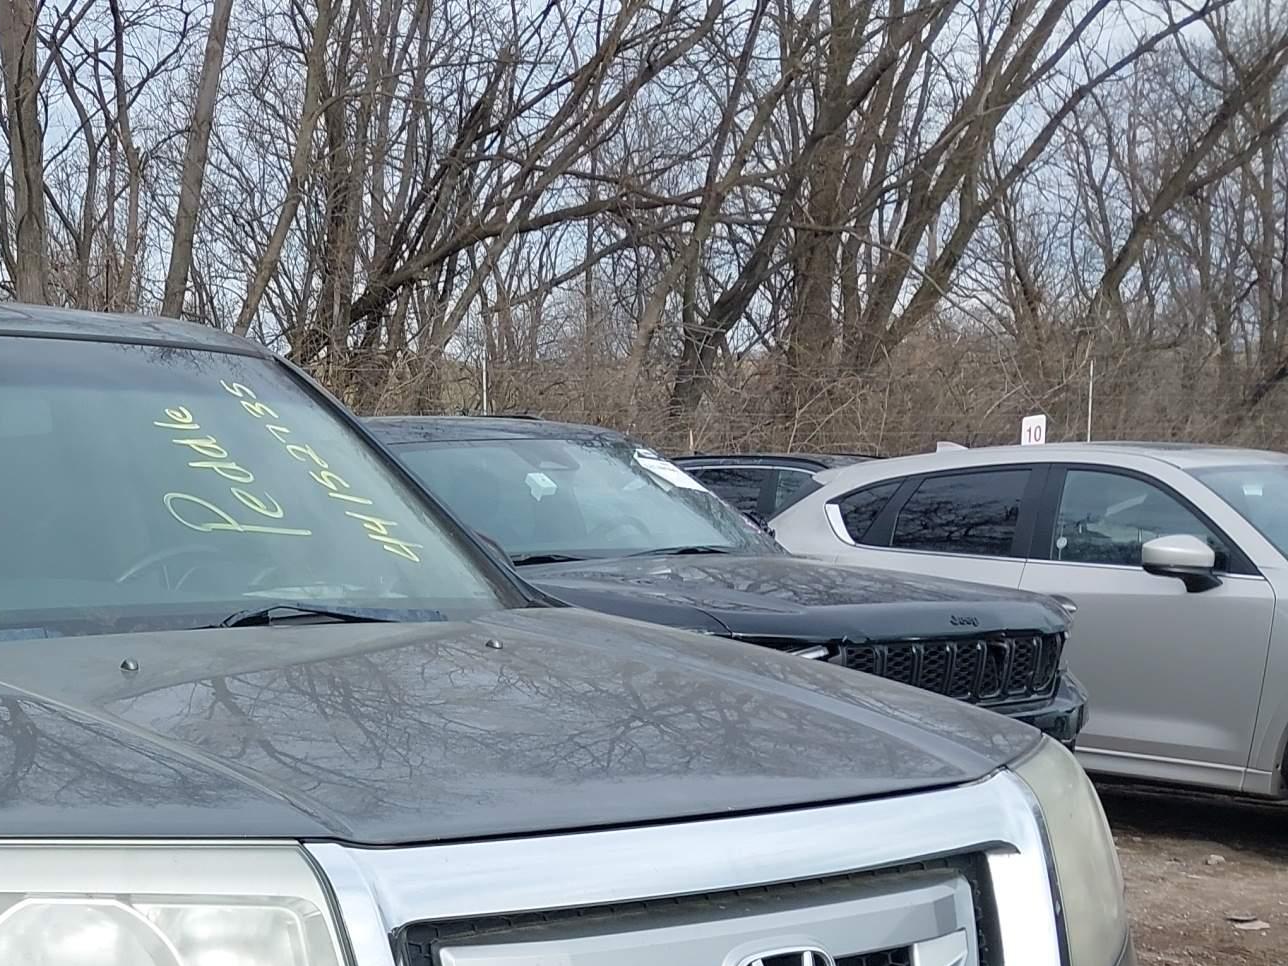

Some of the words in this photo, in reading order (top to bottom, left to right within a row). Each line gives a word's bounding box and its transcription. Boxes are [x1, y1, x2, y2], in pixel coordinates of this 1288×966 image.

[154, 406, 311, 535] Peddle
[220, 379, 423, 563] 44152735
[1026, 425, 1042, 443] 10
